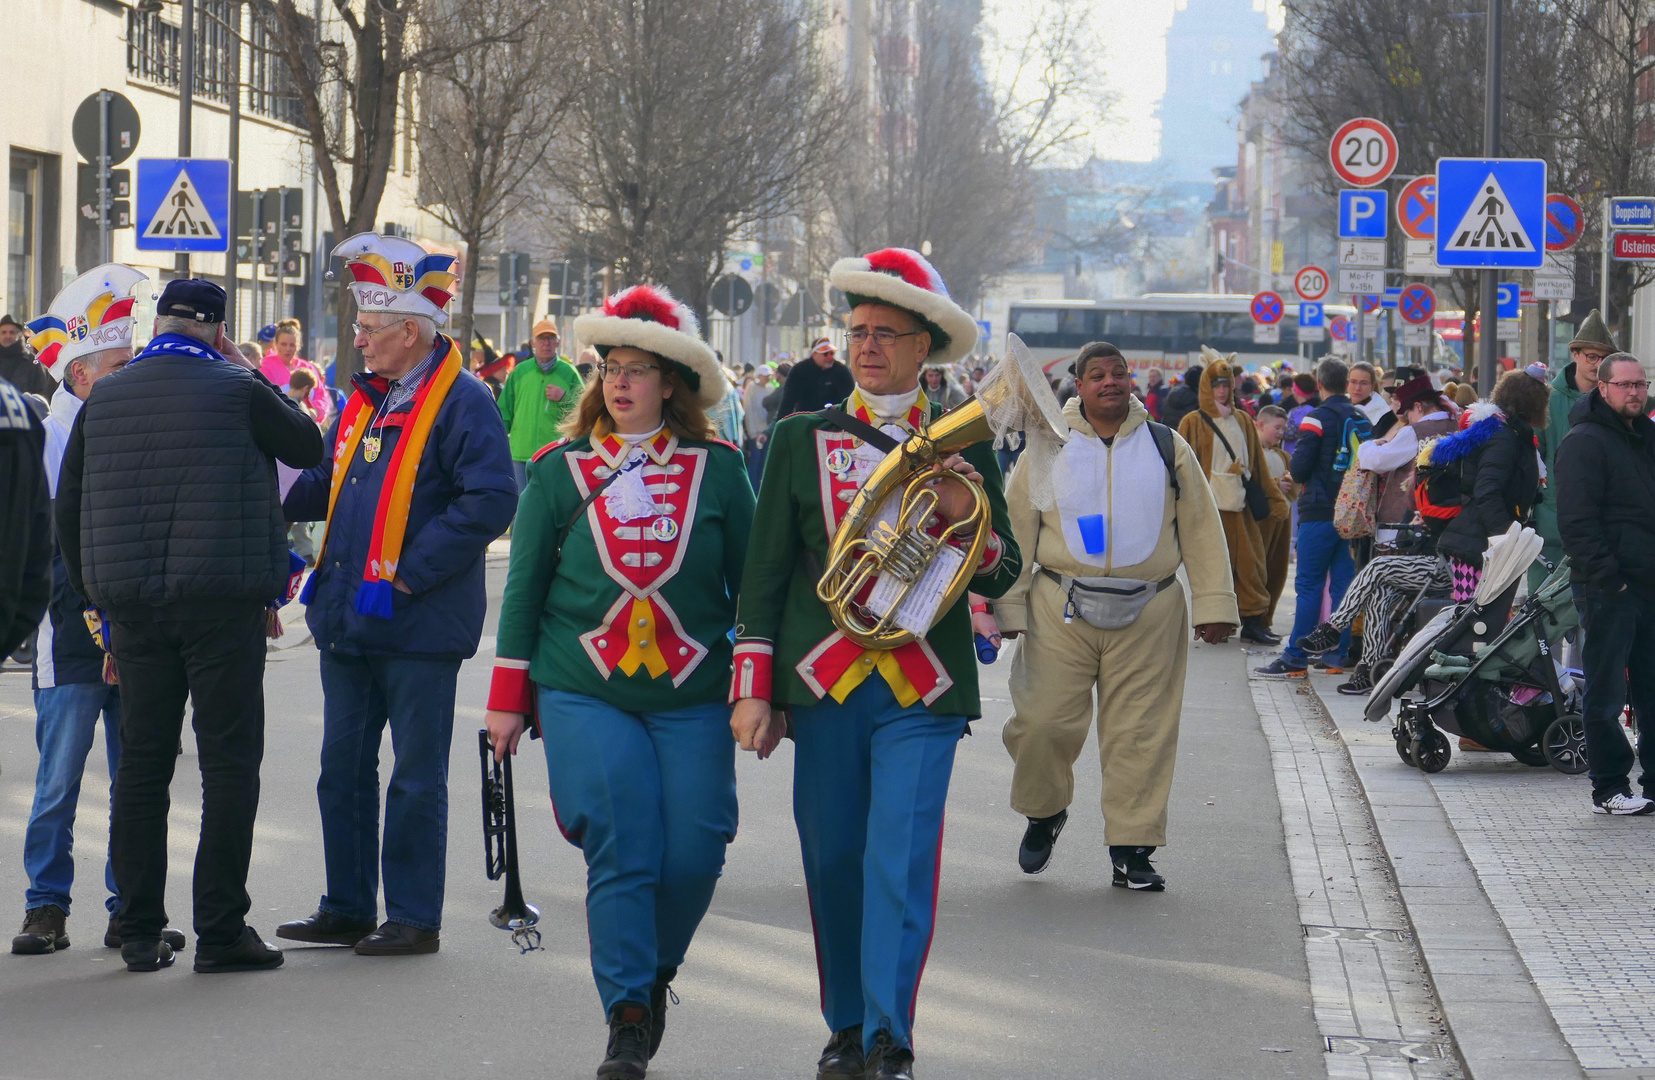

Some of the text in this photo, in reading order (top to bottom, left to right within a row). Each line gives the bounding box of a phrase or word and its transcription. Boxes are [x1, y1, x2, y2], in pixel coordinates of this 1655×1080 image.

[1345, 137, 1383, 167] 20
[1349, 195, 1376, 232] P
[1615, 204, 1652, 222] Boppstraße
[1302, 275, 1322, 291] 20
[1349, 272, 1375, 280] Mo-Fr
[1350, 282, 1373, 292] 9-15h
[1537, 281, 1572, 289] werktags
[359, 290, 397, 307] MCV
[1303, 304, 1319, 324] P
[90, 325, 129, 346] MCV
